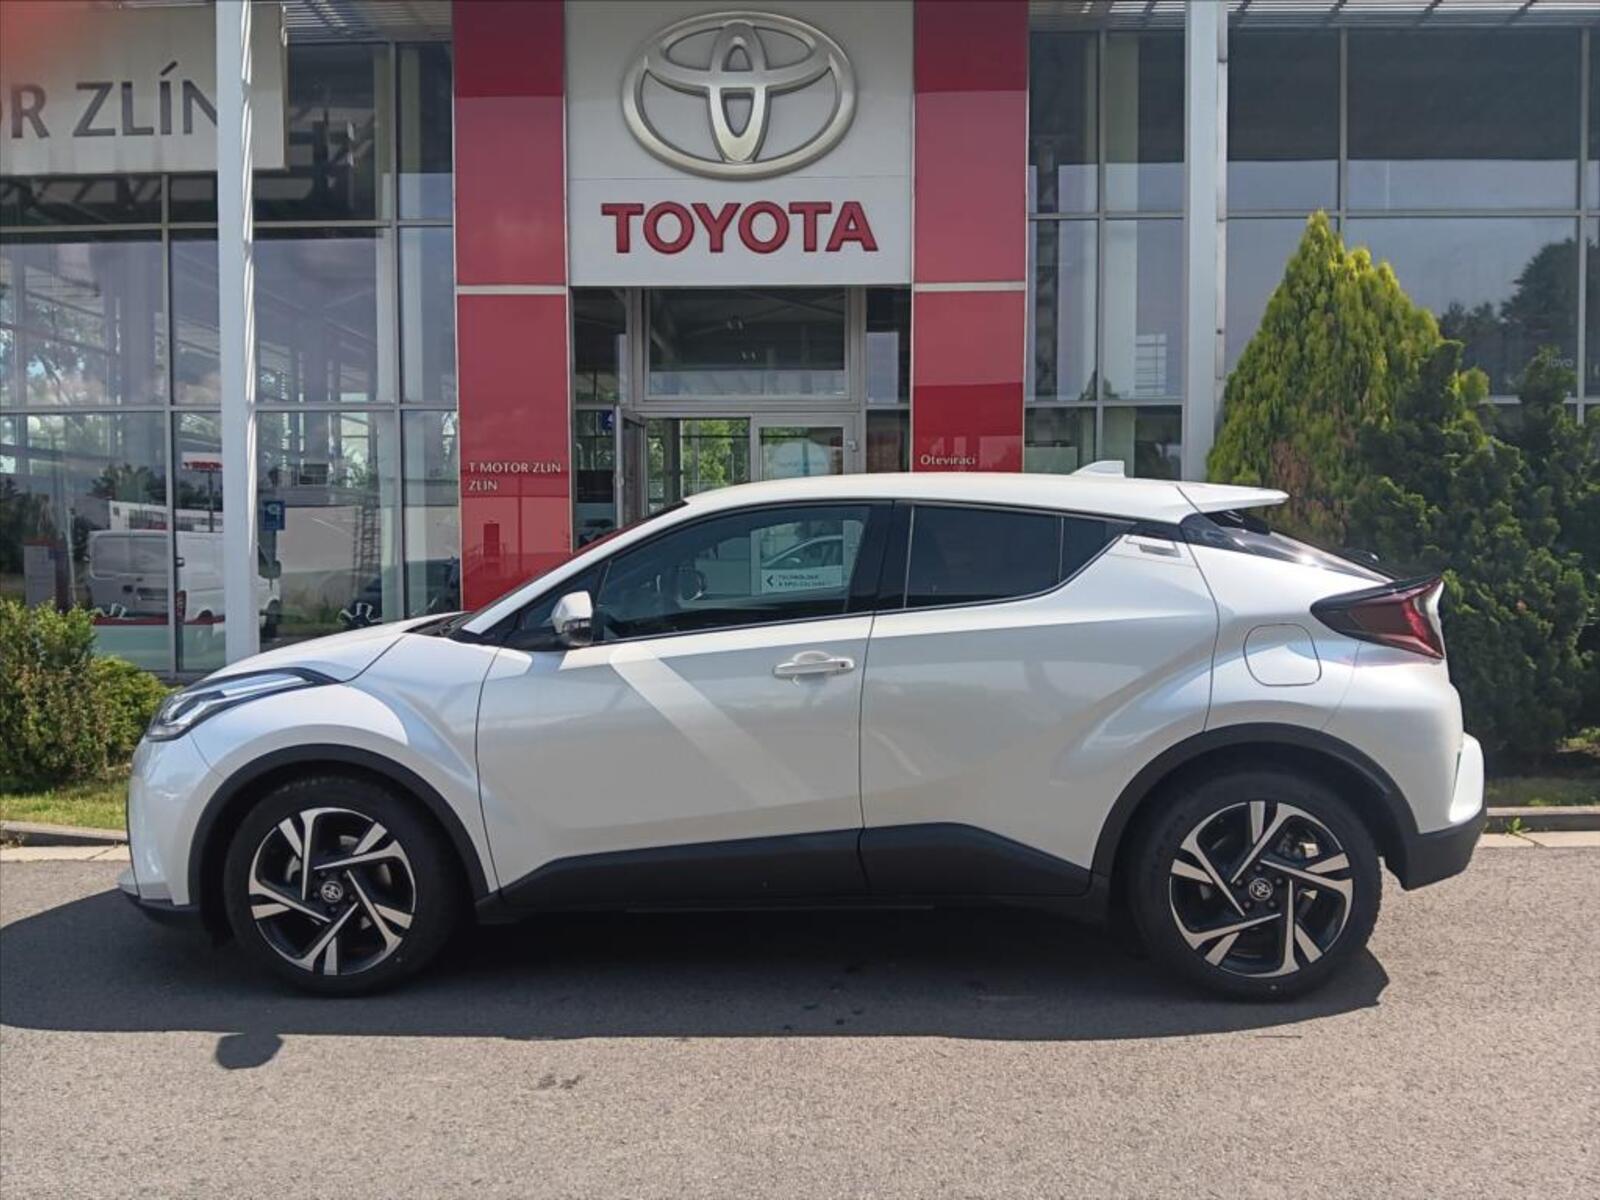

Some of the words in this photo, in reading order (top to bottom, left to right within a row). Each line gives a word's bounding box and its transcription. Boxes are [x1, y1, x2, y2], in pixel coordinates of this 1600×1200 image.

[0, 83, 50, 139] R
[601, 200, 879, 254] TOYOTA
[469, 462, 476, 473] T
[480, 462, 529, 473] MOTOR
